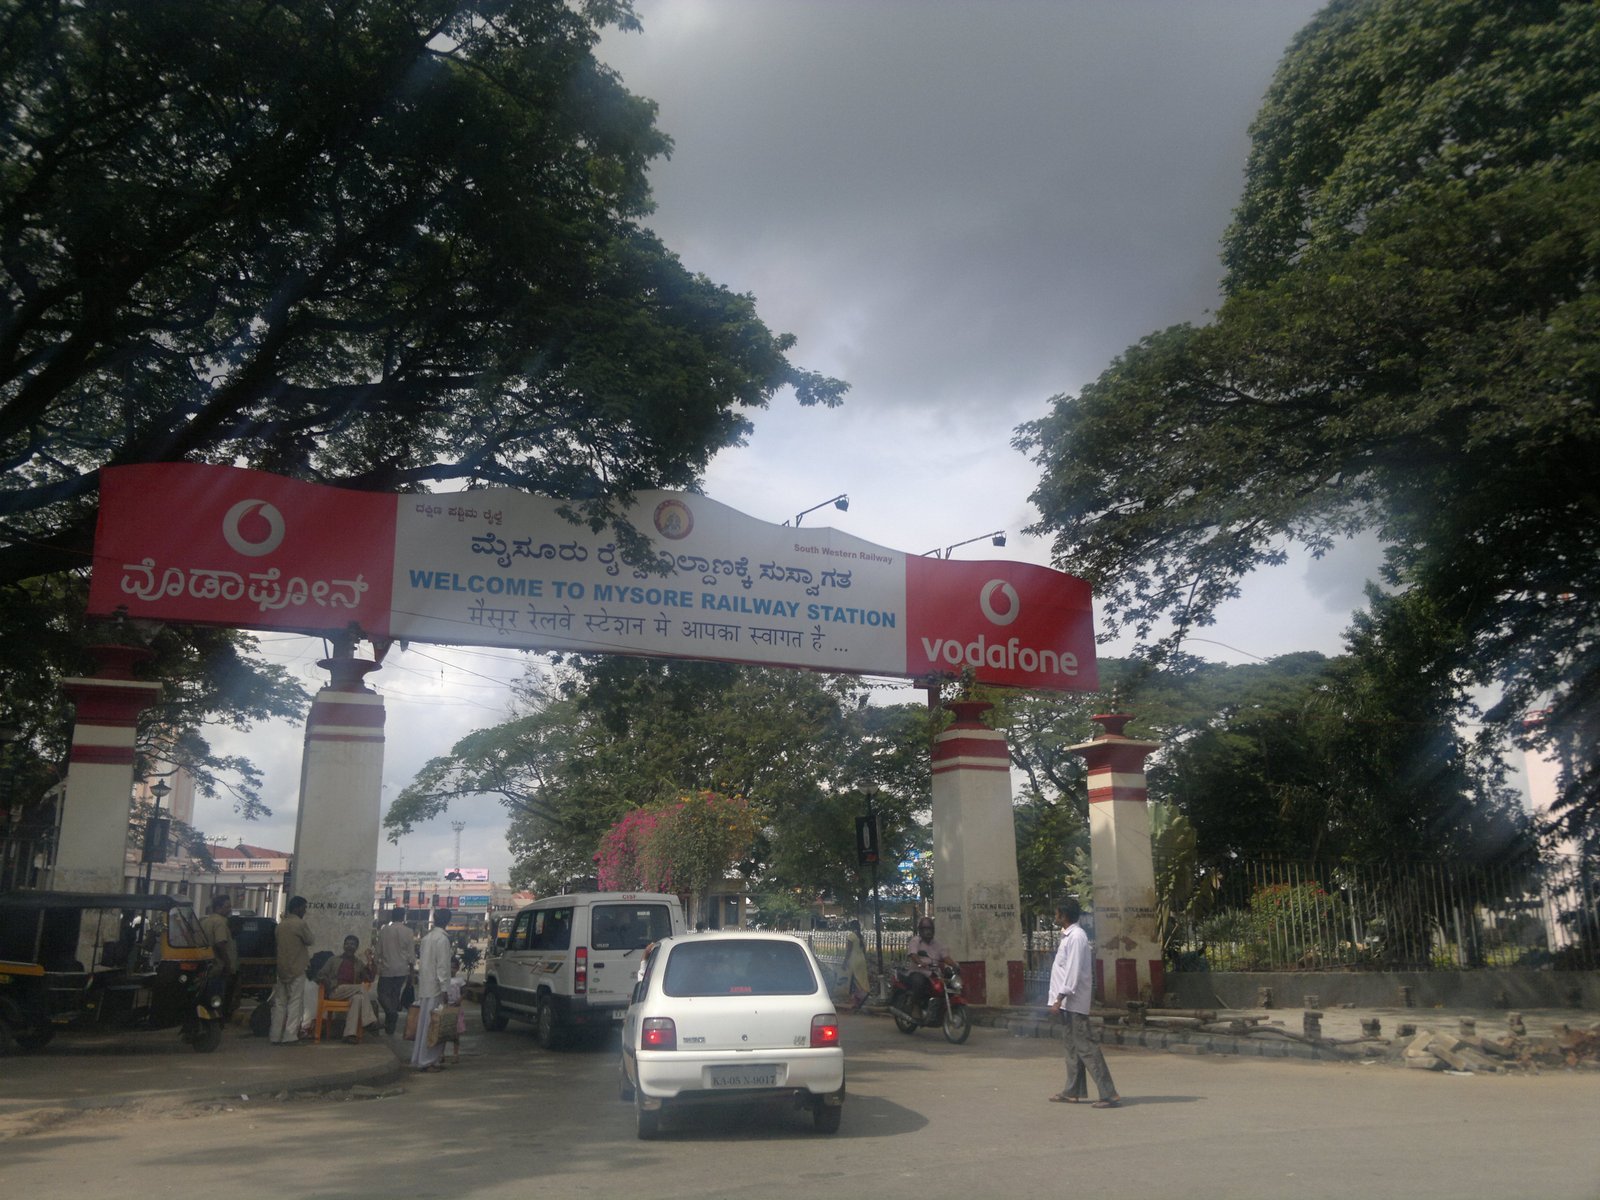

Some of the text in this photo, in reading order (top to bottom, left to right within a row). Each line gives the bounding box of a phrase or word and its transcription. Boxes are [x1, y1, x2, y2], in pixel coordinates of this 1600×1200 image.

[471, 532, 588, 568] ಮೈಸೂರು
[759, 560, 852, 597] ಸುಸ್ವಾಗತ
[794, 543, 893, 565] South Western Railway
[409, 569, 896, 628] WELCOME TO MYSORE RAILWAY STATION
[467, 598, 519, 635] मैसूर
[527, 602, 576, 631] रेलवे
[584, 607, 646, 635] स्टेशन
[681, 620, 741, 642] आपका
[748, 626, 804, 648] स्वागत
[921, 633, 1079, 676] vodafone
